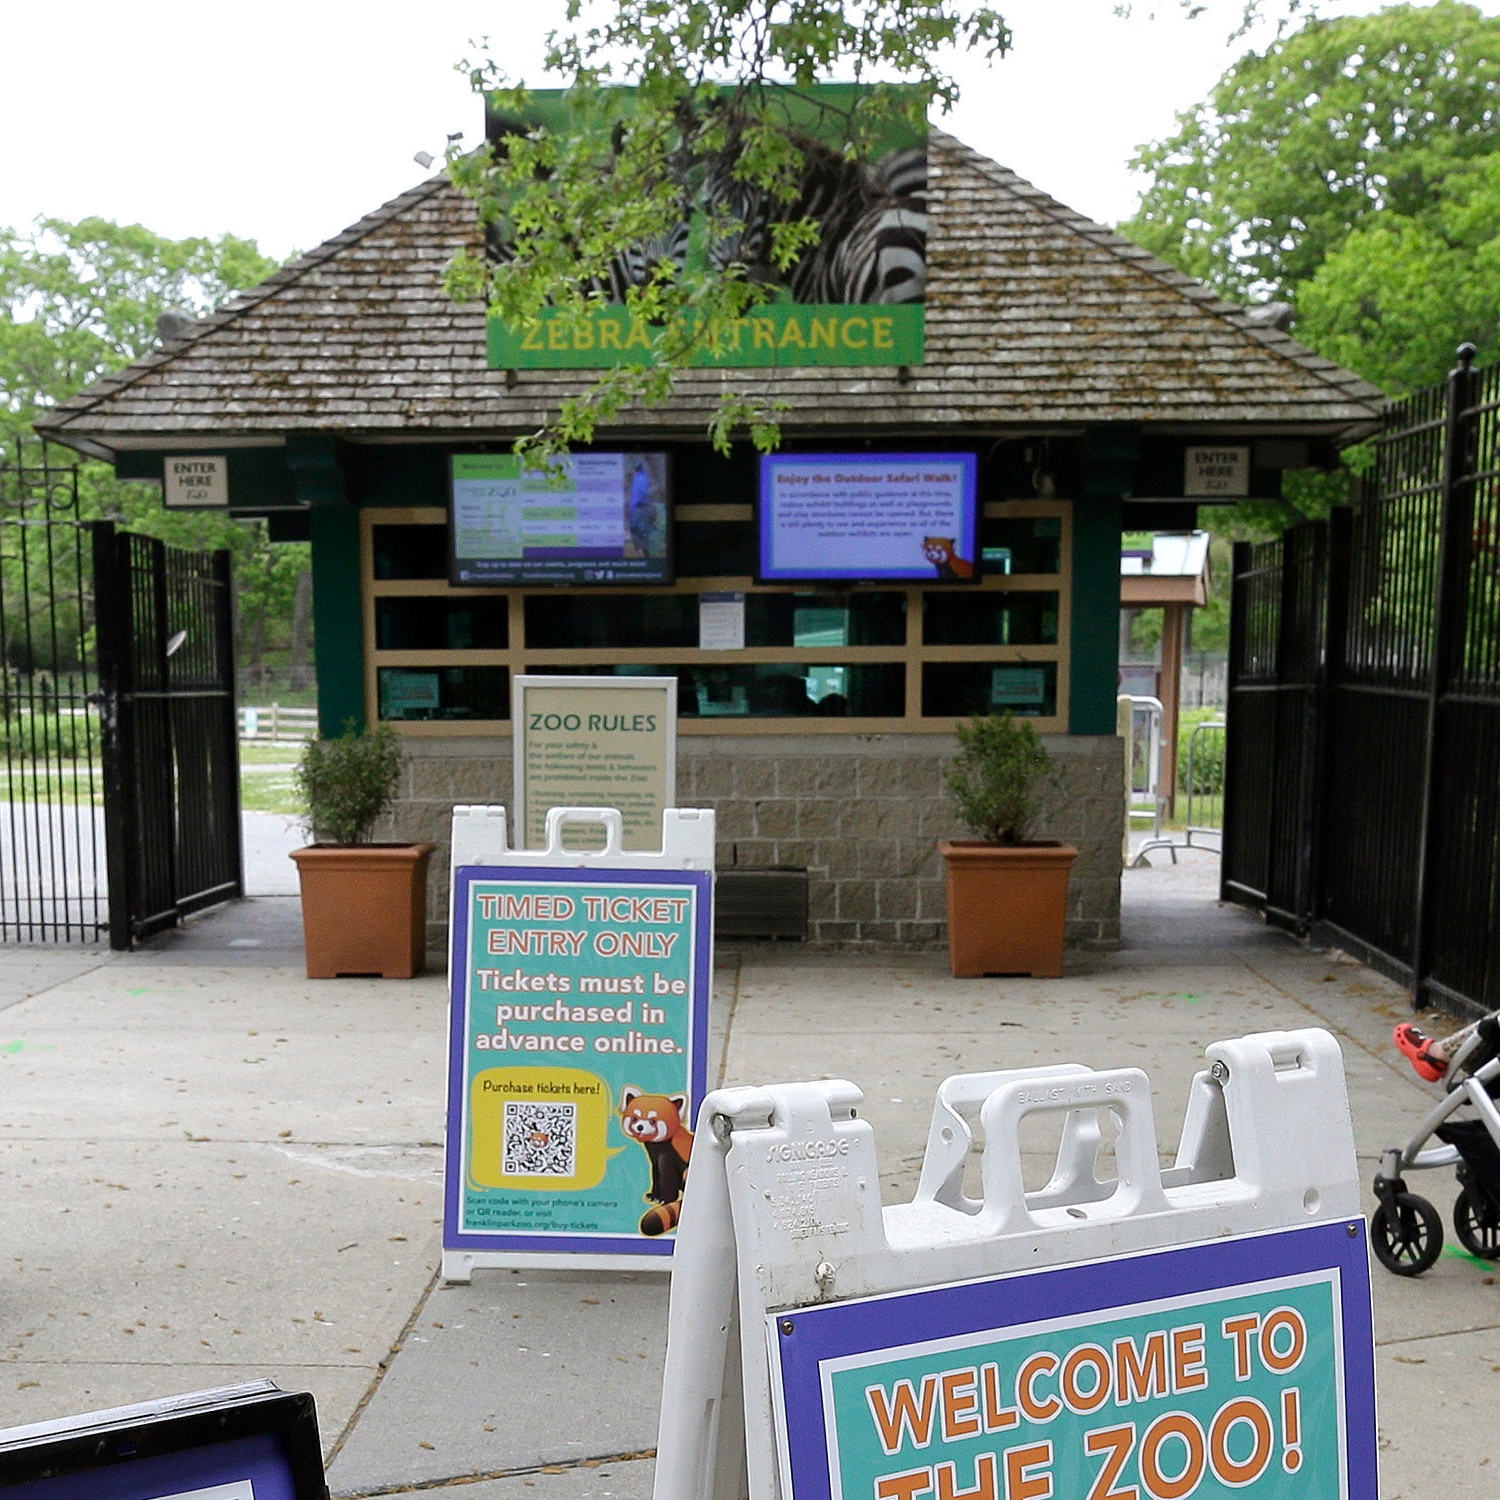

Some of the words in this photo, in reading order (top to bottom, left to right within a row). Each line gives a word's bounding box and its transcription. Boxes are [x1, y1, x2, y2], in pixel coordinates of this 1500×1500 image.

[520, 319, 654, 351] ZEBRA
[1194, 452, 1238, 463] ENTER
[174, 463, 216, 474] ENTER
[1198, 466, 1233, 477] HERE
[179, 475, 212, 486] HERE
[777, 474, 808, 486] Enjoy
[812, 474, 830, 483] the
[529, 713, 581, 731] ZOO
[588, 714, 657, 732] RULES
[478, 895, 574, 919] TIMED
[583, 897, 688, 921] TICKET
[489, 930, 586, 954] ENTRY
[595, 931, 677, 956] ONLY
[476, 969, 571, 992] Tickets
[579, 974, 645, 994] must
[653, 972, 686, 994] be
[496, 999, 633, 1025] purchased
[641, 1003, 665, 1023] in
[475, 1028, 586, 1051] advance
[594, 1030, 684, 1053] online.
[482, 1079, 533, 1093] Purchase
[536, 1081, 571, 1094] tickets
[572, 1081, 600, 1095] here!
[465, 1195, 487, 1205] Scan
[486, 1195, 510, 1206] code
[510, 1197, 530, 1205] with
[585, 1200, 619, 1208] camera
[865, 1323, 1208, 1455] WELCOME
[1221, 1305, 1307, 1381] TO
